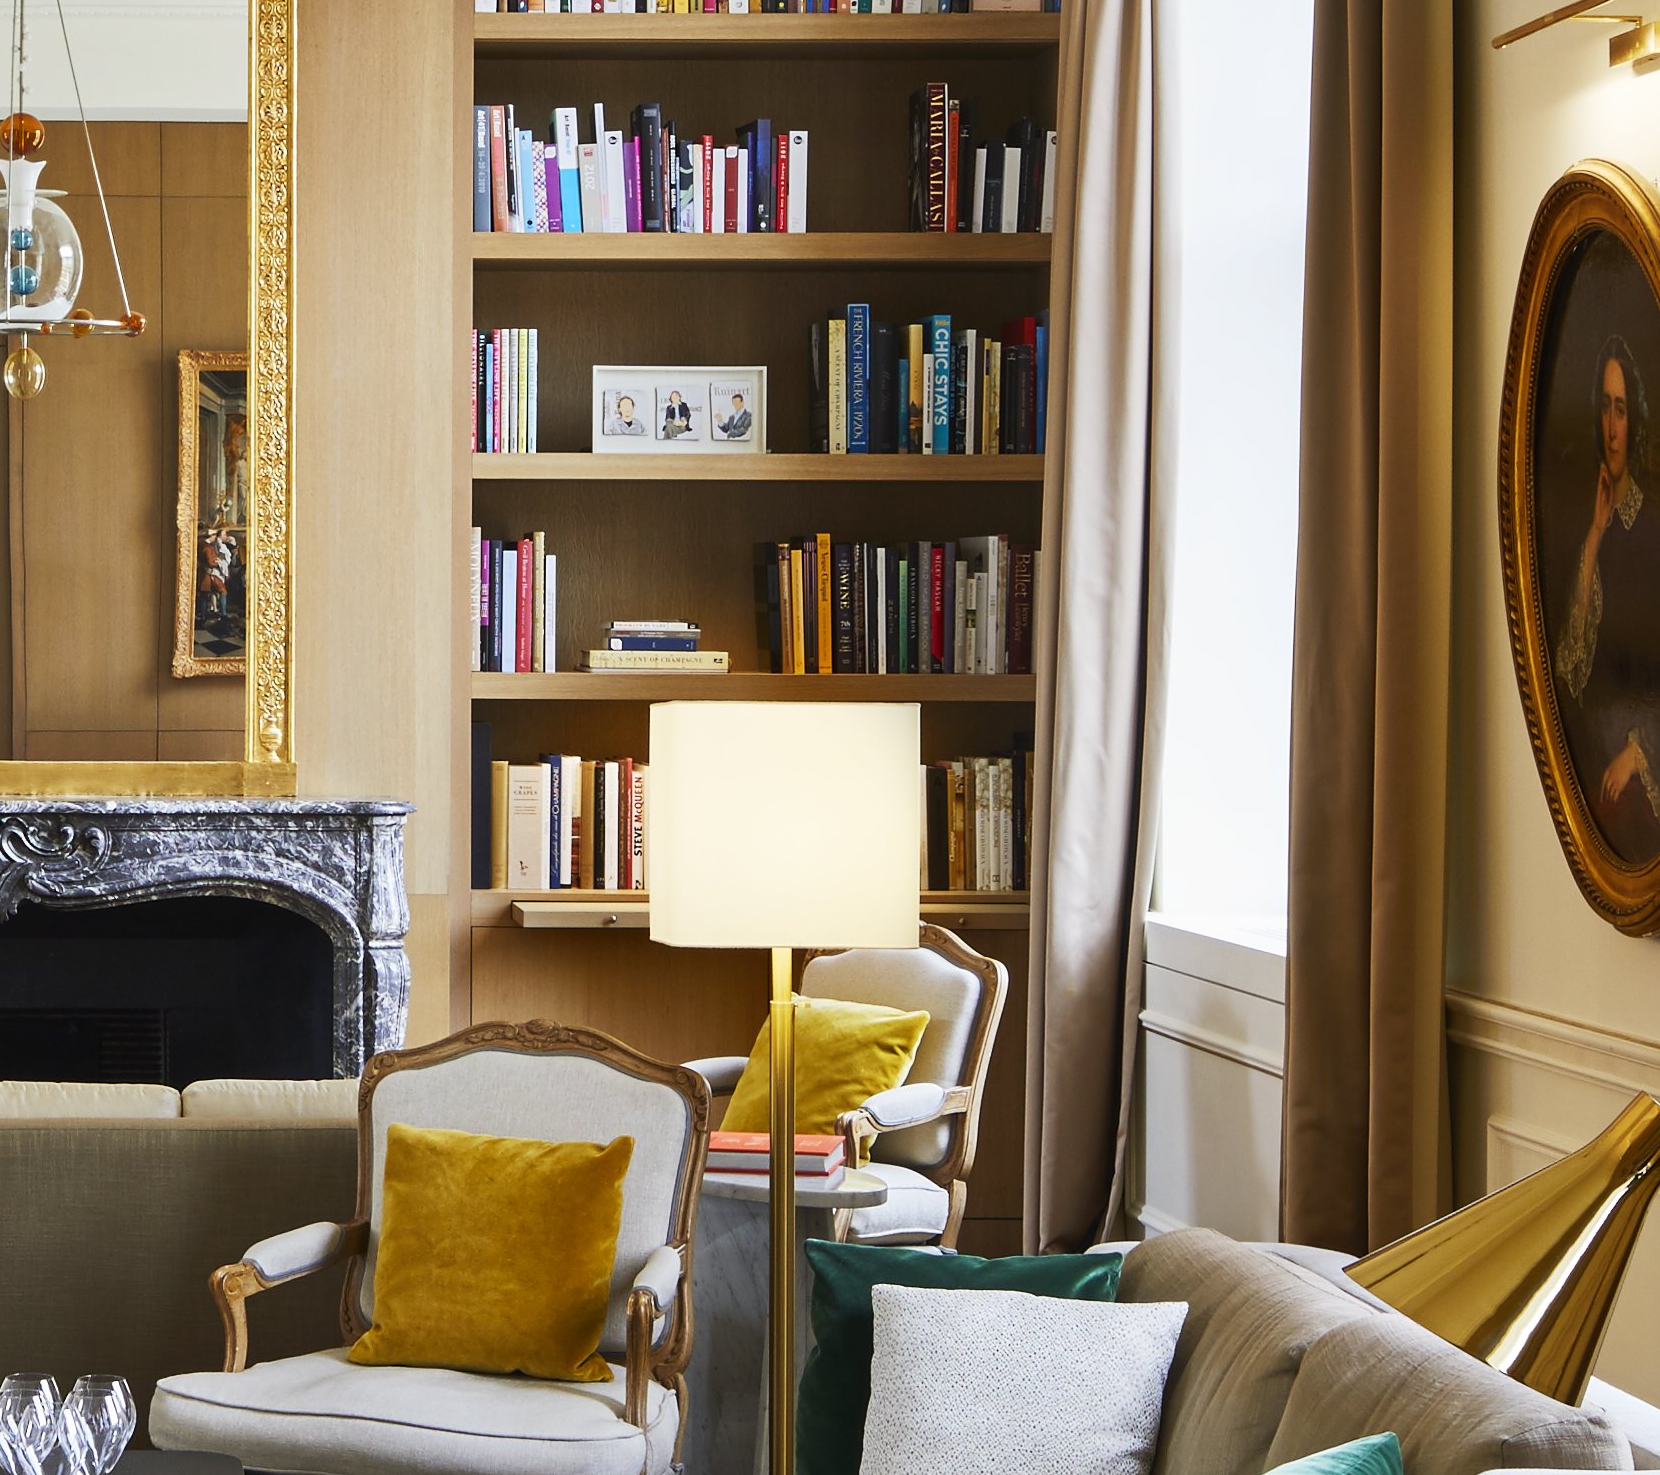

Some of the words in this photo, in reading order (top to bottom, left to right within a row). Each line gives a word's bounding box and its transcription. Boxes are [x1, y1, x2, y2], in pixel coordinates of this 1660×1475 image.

[930, 94, 943, 149] MARIA
[584, 164, 595, 191] 2012
[930, 156, 943, 222] CALLAS
[853, 314, 864, 359] FRENCH
[934, 328, 949, 369] CHIC
[853, 363, 864, 403] RIVIERA
[934, 375, 949, 425] STAYS
[853, 412, 864, 439] 1920s
[820, 552, 829, 572] Veuve
[921, 551, 929, 579] WORLD
[1014, 553, 1031, 598] Ballet
[840, 573, 850, 609] WINE
[1022, 603, 1030, 627] Henry
[633, 777, 643, 823] McQUEEN
[633, 826, 643, 857] STEVE
